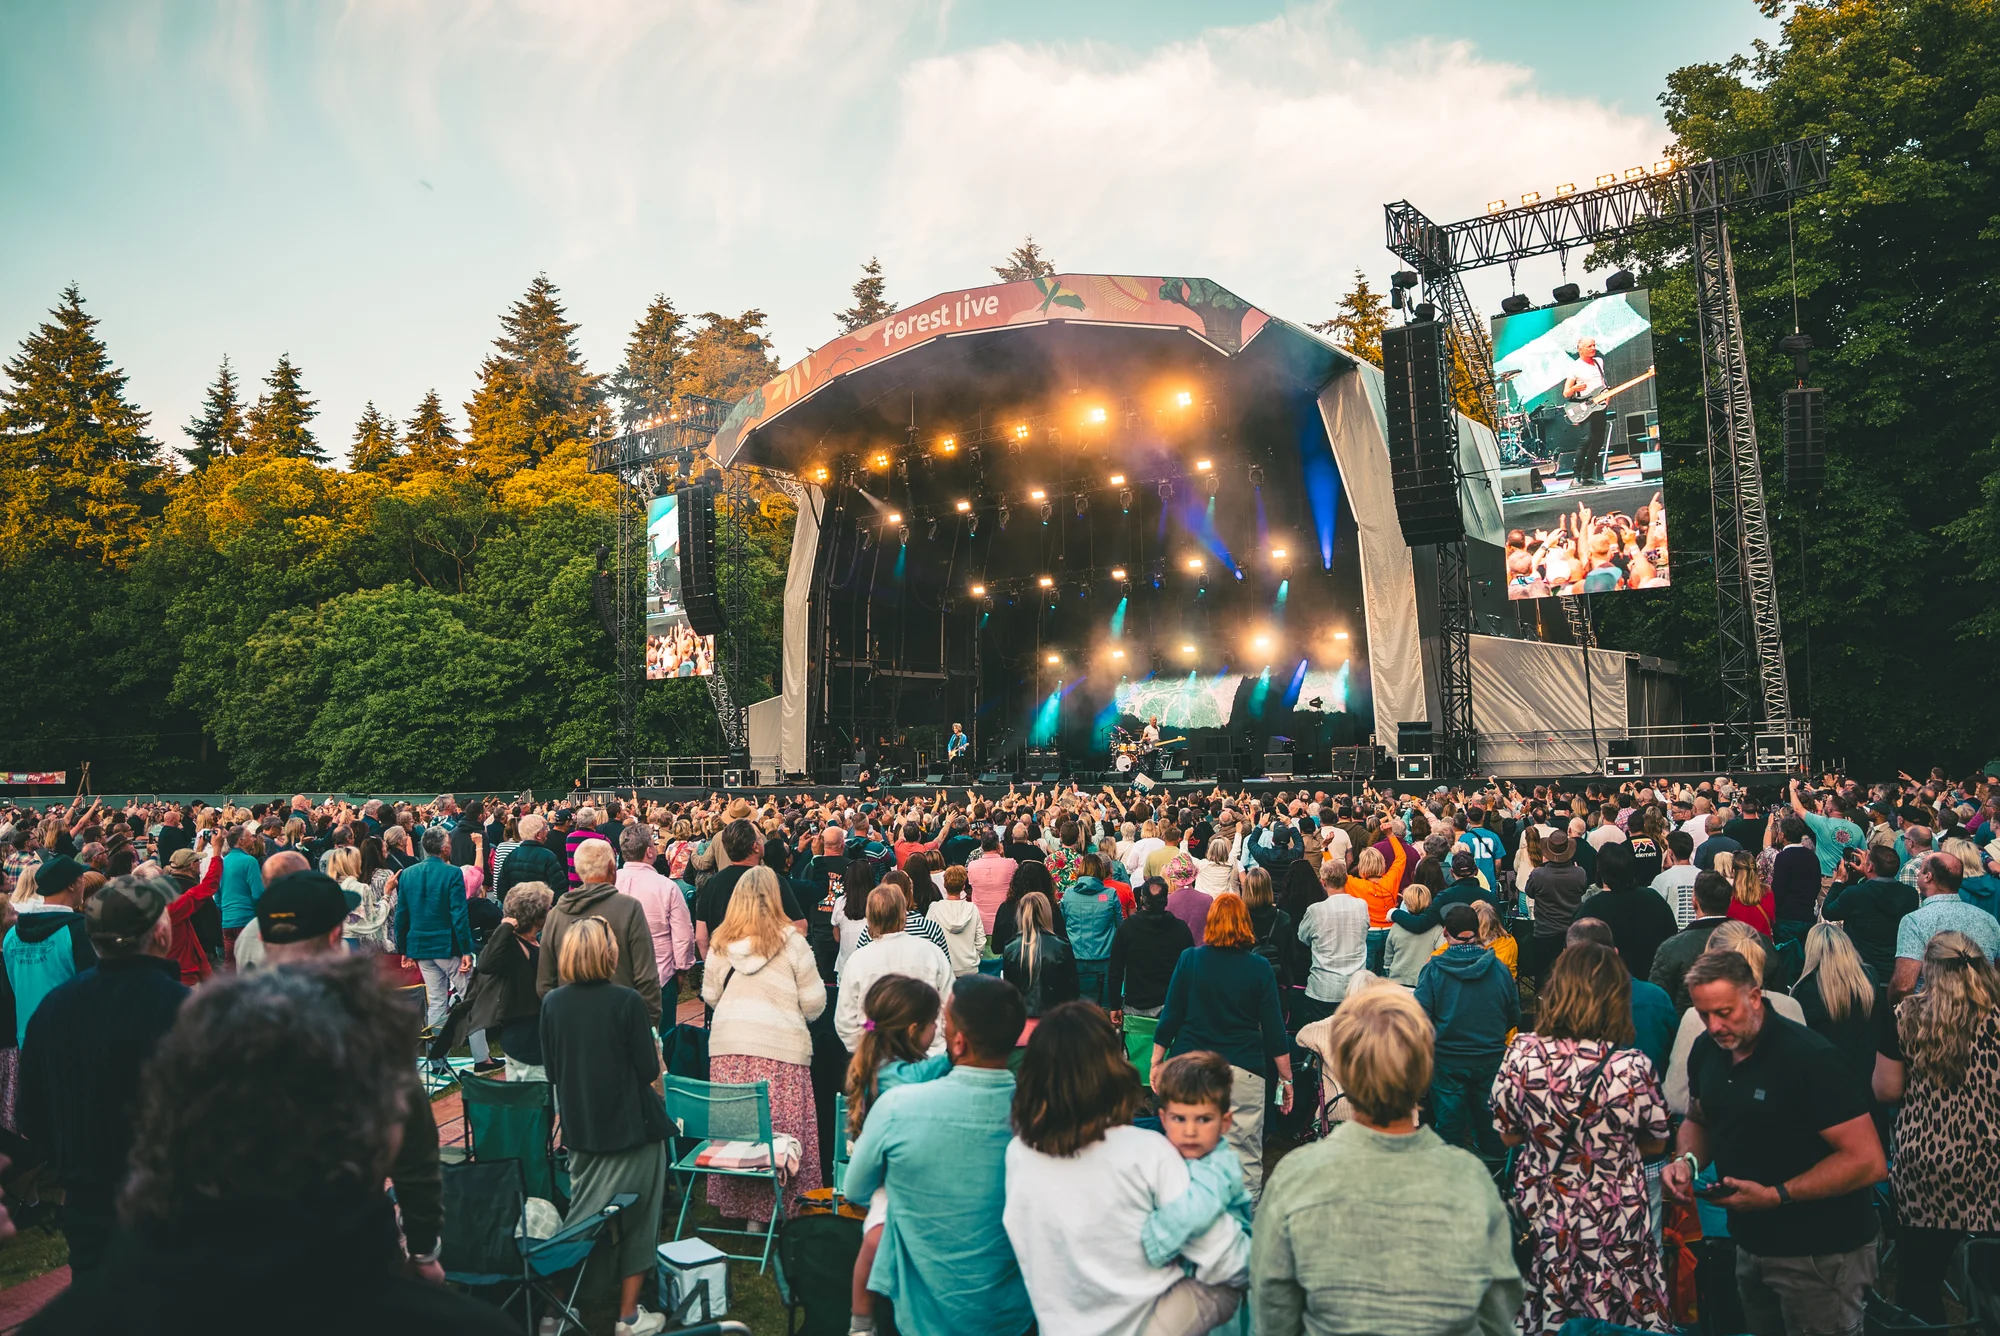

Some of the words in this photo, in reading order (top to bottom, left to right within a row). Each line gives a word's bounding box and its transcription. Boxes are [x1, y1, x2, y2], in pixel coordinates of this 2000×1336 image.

[883, 304, 950, 347] forest
[956, 293, 998, 327] live
[28, 774, 41, 782] Play
[1472, 837, 1493, 858] 10
